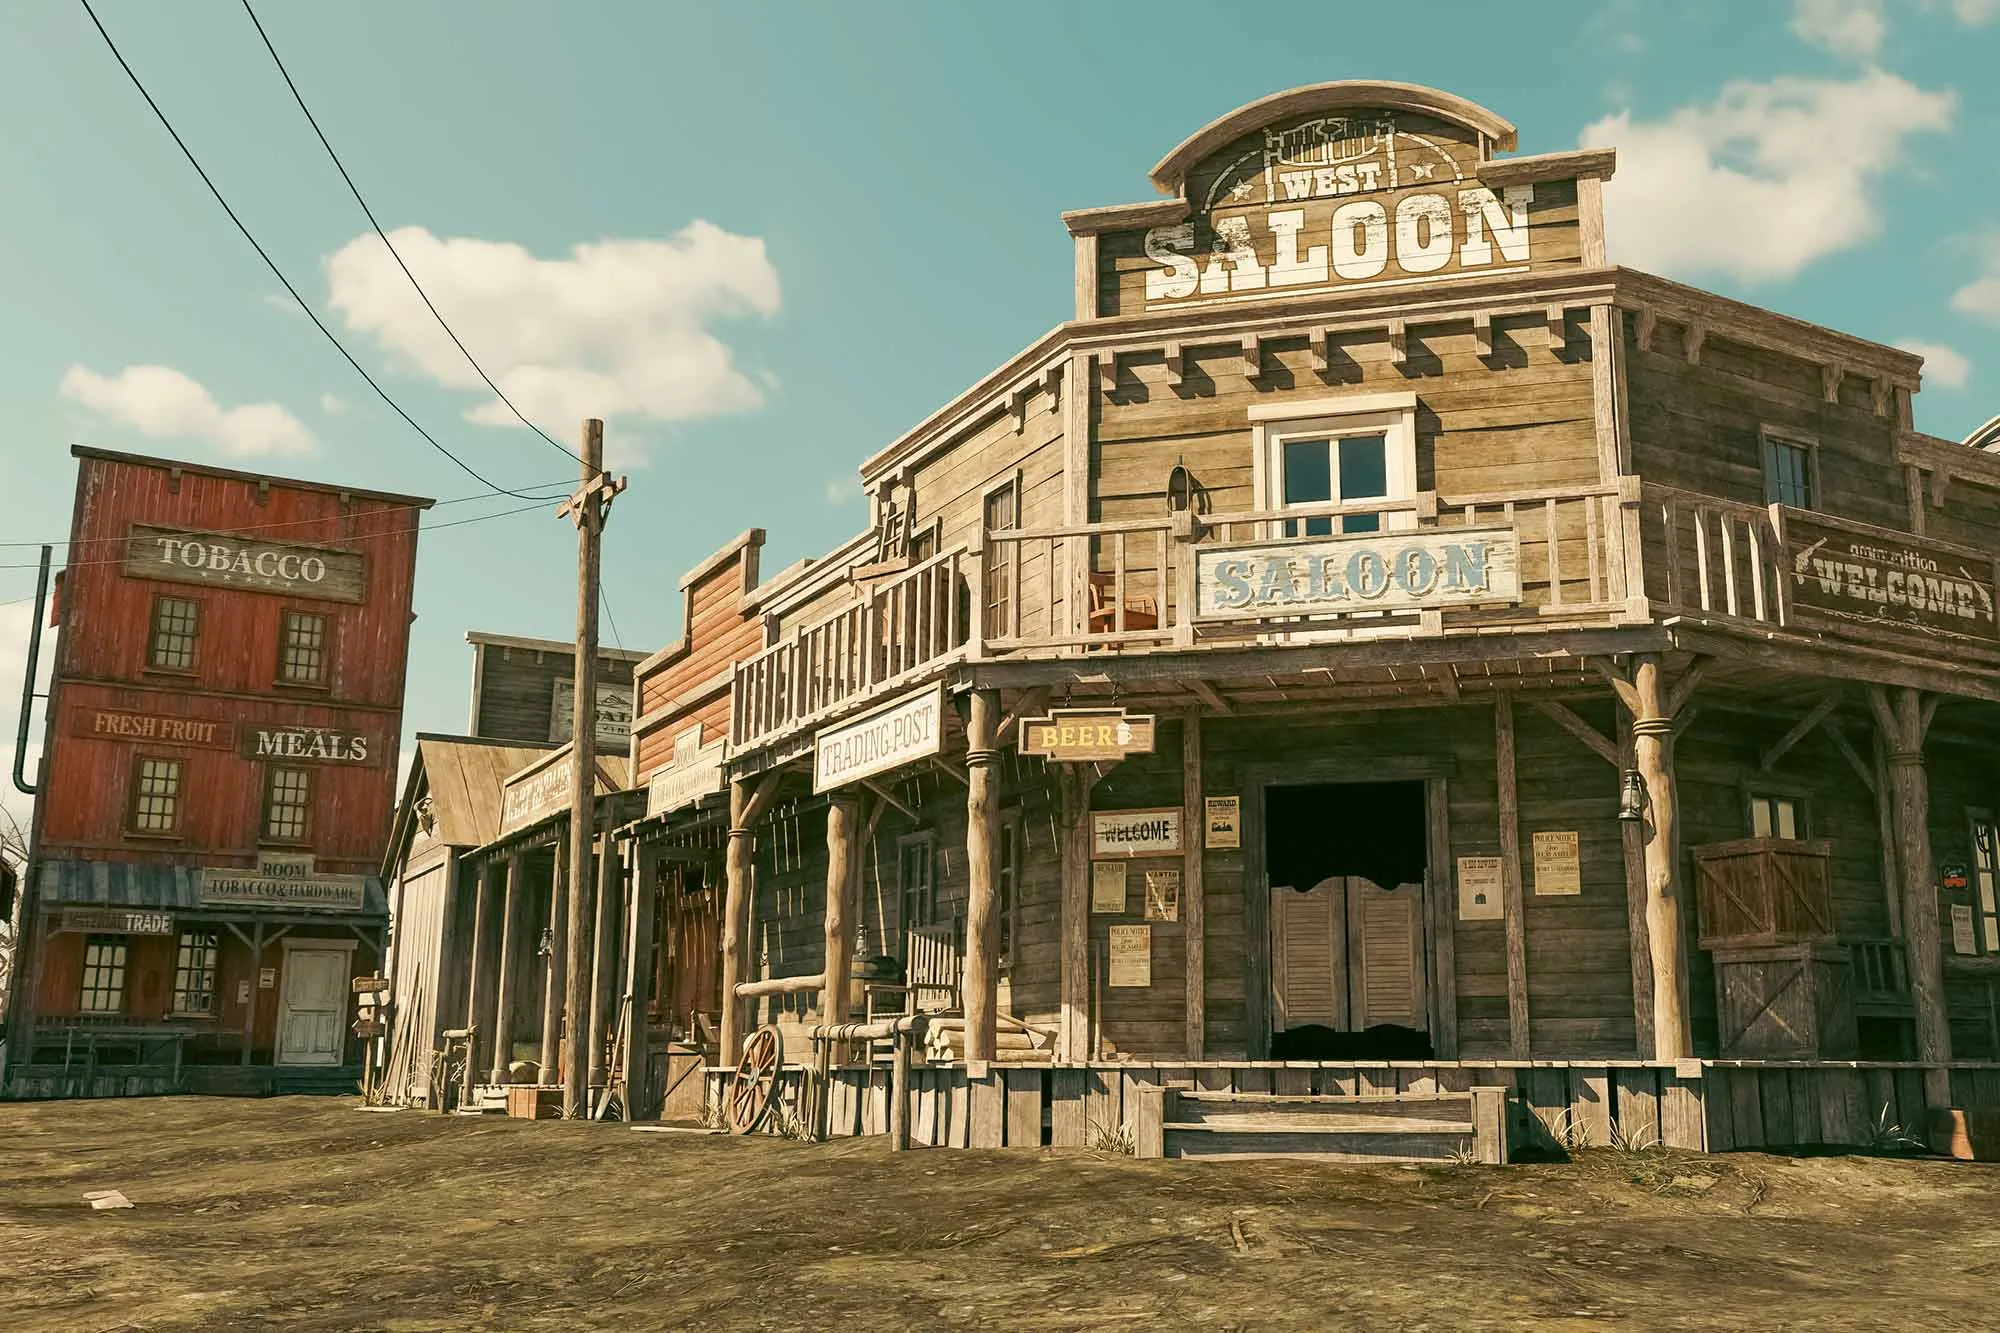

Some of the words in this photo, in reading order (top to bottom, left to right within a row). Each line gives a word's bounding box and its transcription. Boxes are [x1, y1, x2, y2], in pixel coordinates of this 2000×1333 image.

[1279, 161, 1382, 200] WEST
[1144, 183, 1535, 301] SALOON
[157, 537, 326, 583] TOBACCO
[1213, 543, 1494, 607] SALOON
[1812, 558, 1976, 619] WELCOME
[94, 713, 158, 737] FRESH
[160, 719, 216, 742] FRUIT
[823, 722, 889, 776] TRADING
[893, 705, 932, 752] POST
[1040, 725, 1115, 748] BEER
[256, 731, 367, 760] MEALS
[1105, 820, 1169, 843] WELCOME
[262, 863, 306, 877] ROOM
[125, 914, 170, 933] TRADE
